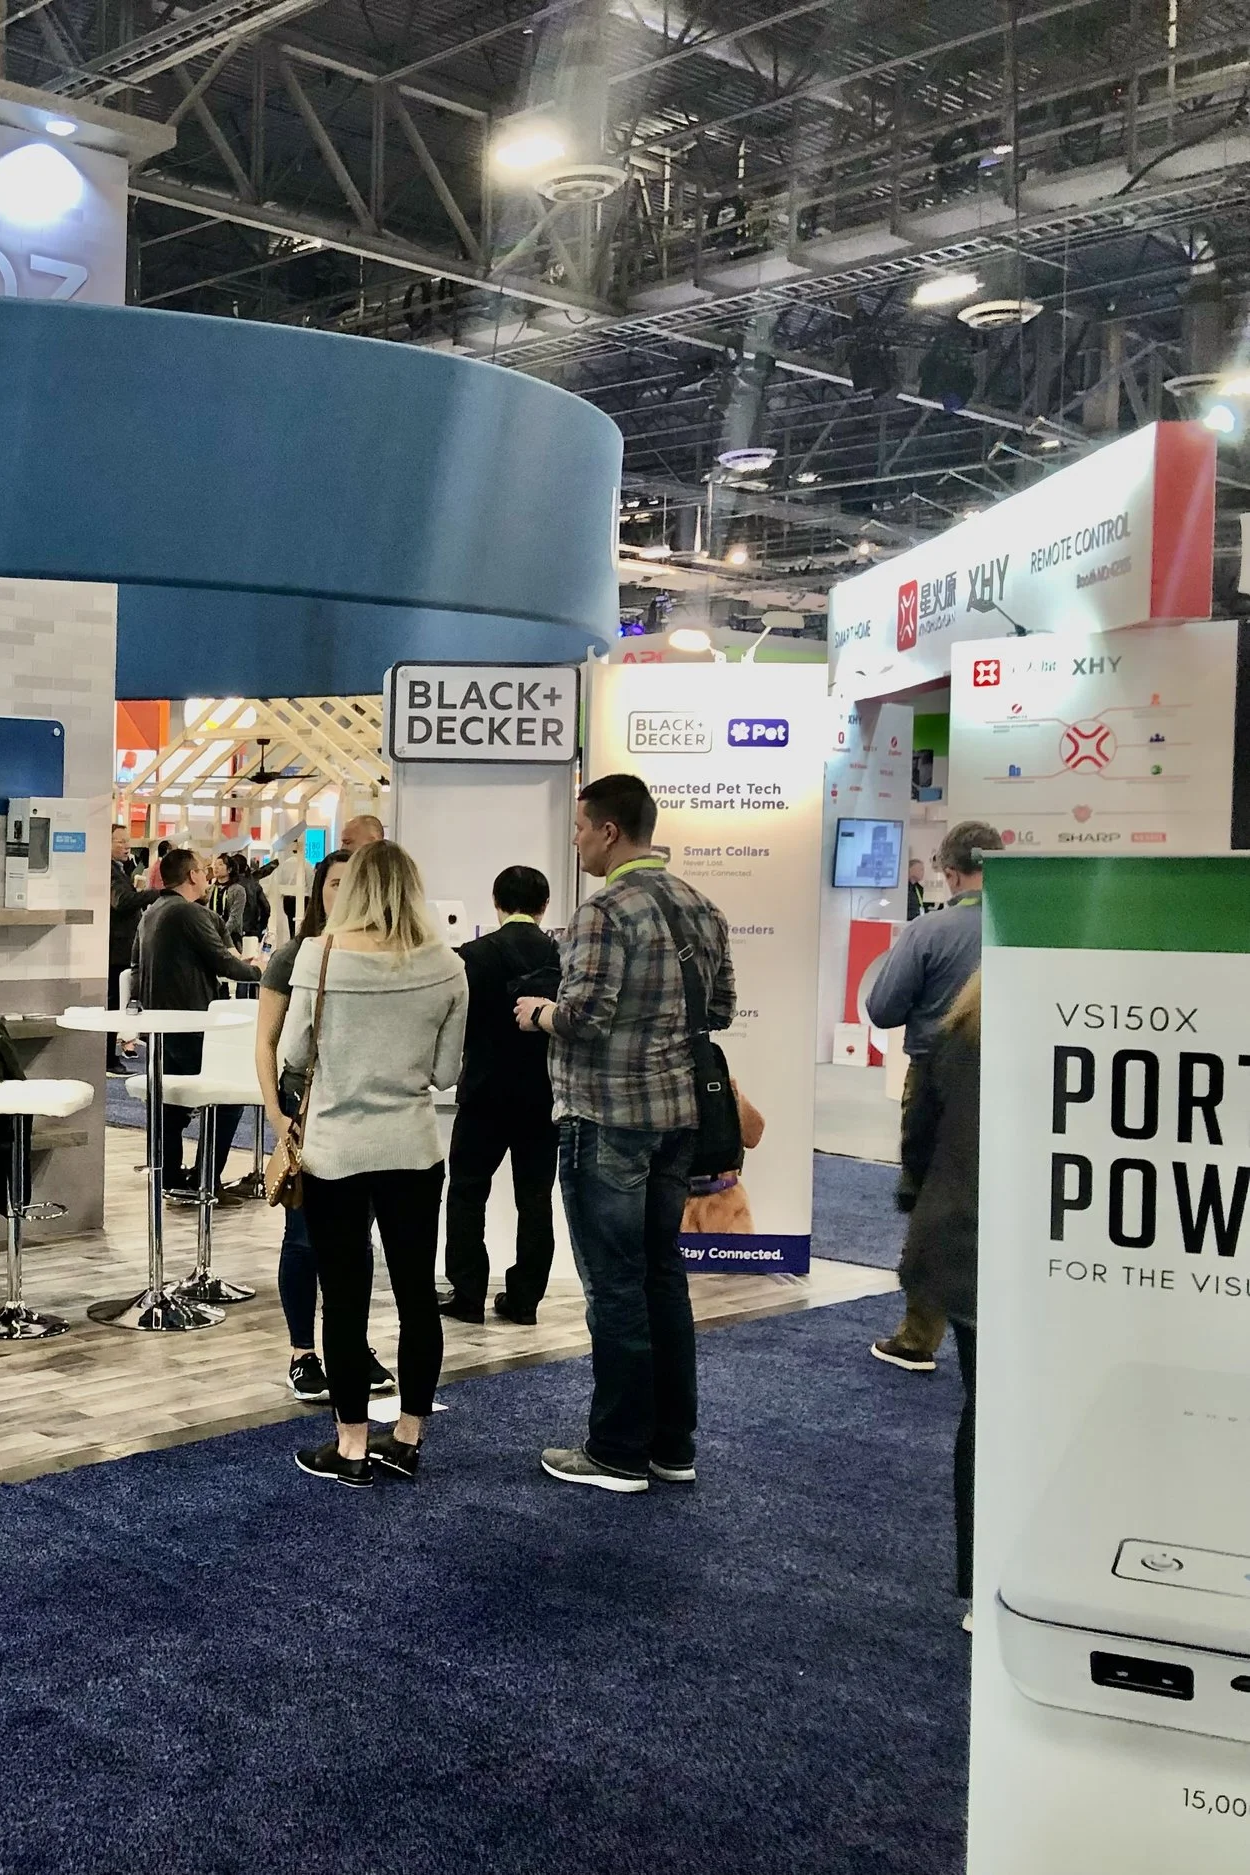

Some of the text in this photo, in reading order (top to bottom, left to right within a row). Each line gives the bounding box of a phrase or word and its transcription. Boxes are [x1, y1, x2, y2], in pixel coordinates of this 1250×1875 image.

[1031, 536, 1072, 575] REMOTE
[1074, 511, 1132, 557] CONTROL
[966, 553, 1010, 613] XHY
[1071, 655, 1123, 676] XHY
[408, 679, 564, 712] BLACK+
[406, 715, 565, 748] DECKER
[634, 733, 706, 746] DECKER
[752, 723, 786, 742] Pet
[716, 782, 741, 795] Pet
[747, 783, 782, 795] Tech
[690, 797, 736, 810] Smart
[740, 798, 790, 810] Home.
[1057, 832, 1122, 843] SHARP
[683, 846, 770, 857] Smart Collars
[683, 859, 705, 867] Never
[682, 869, 710, 878] Always
[1055, 1001, 1199, 1034] VS150X
[1051, 1044, 1250, 1146] POR
[708, 1247, 784, 1261] Connected.
[1048, 1258, 1250, 1298] FOR THE VIS
[1182, 1787, 1250, 1818] 15,00
